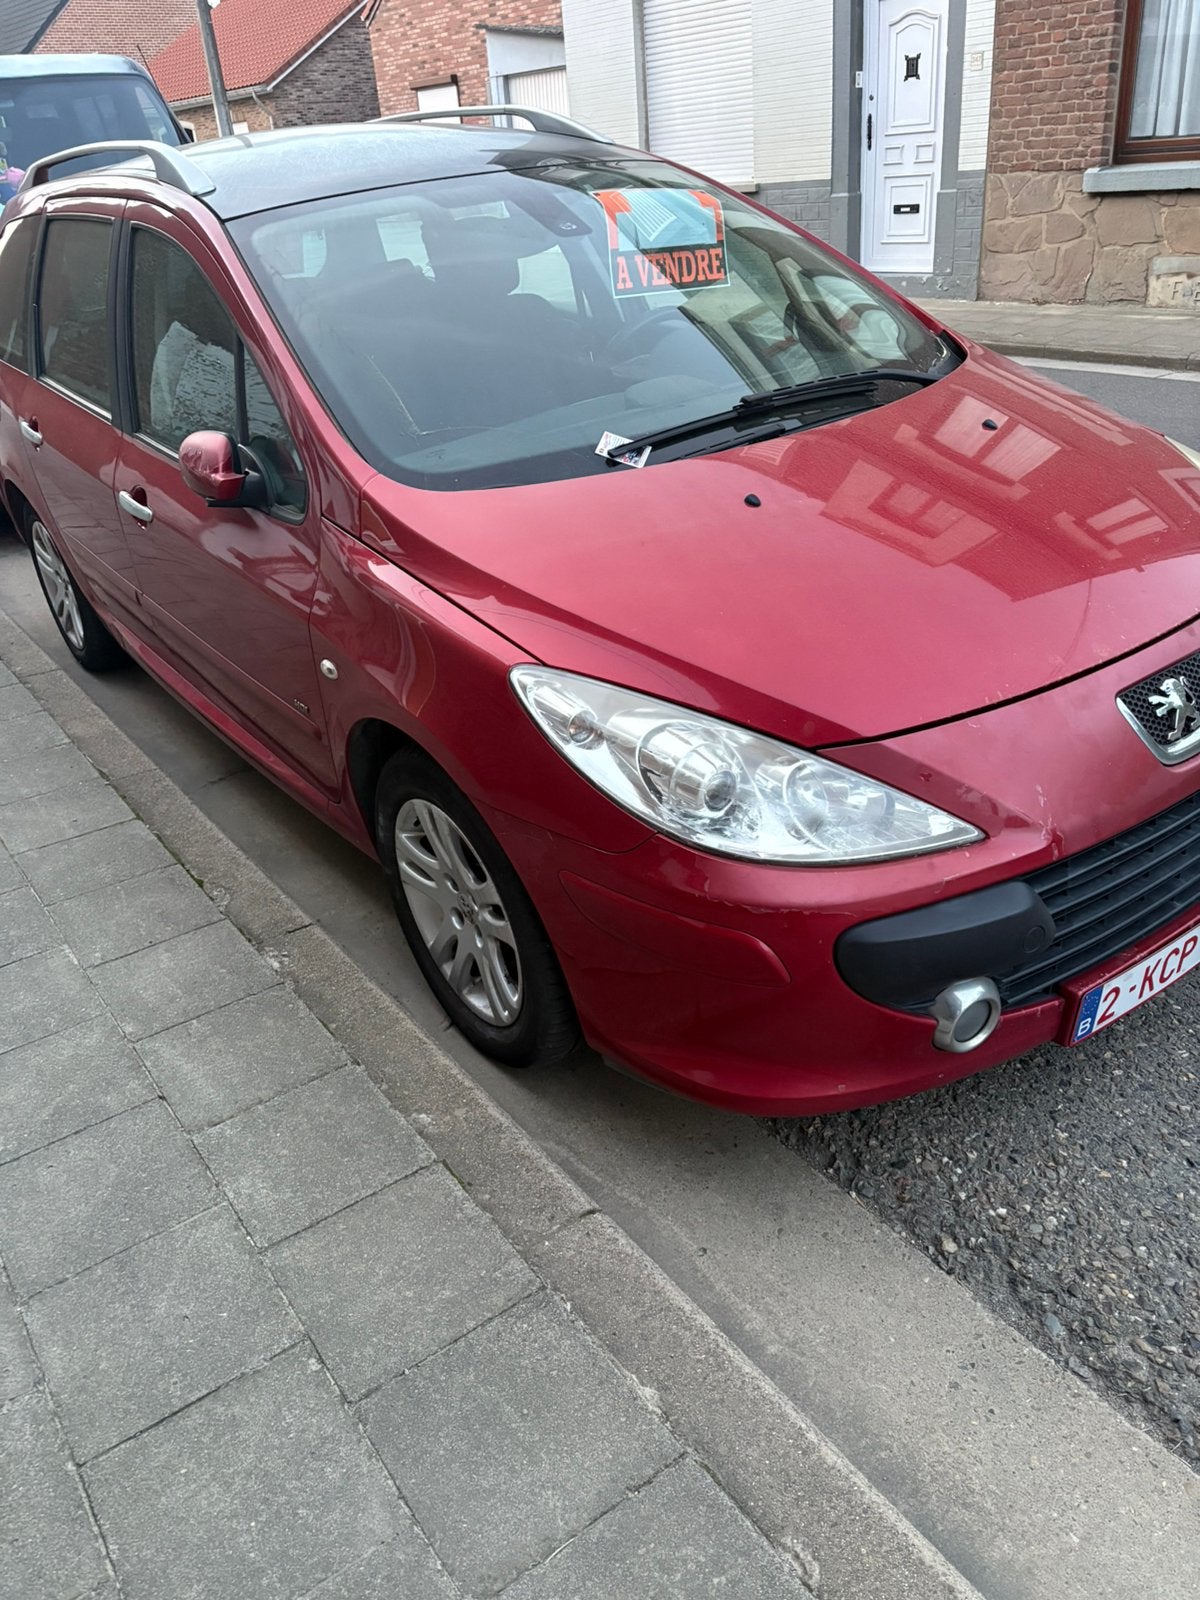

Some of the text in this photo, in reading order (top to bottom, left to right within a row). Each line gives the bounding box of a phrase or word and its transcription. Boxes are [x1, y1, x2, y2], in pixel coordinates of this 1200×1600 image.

[617, 248, 725, 289] A VENDRE
[1077, 1018, 1091, 1036] B
